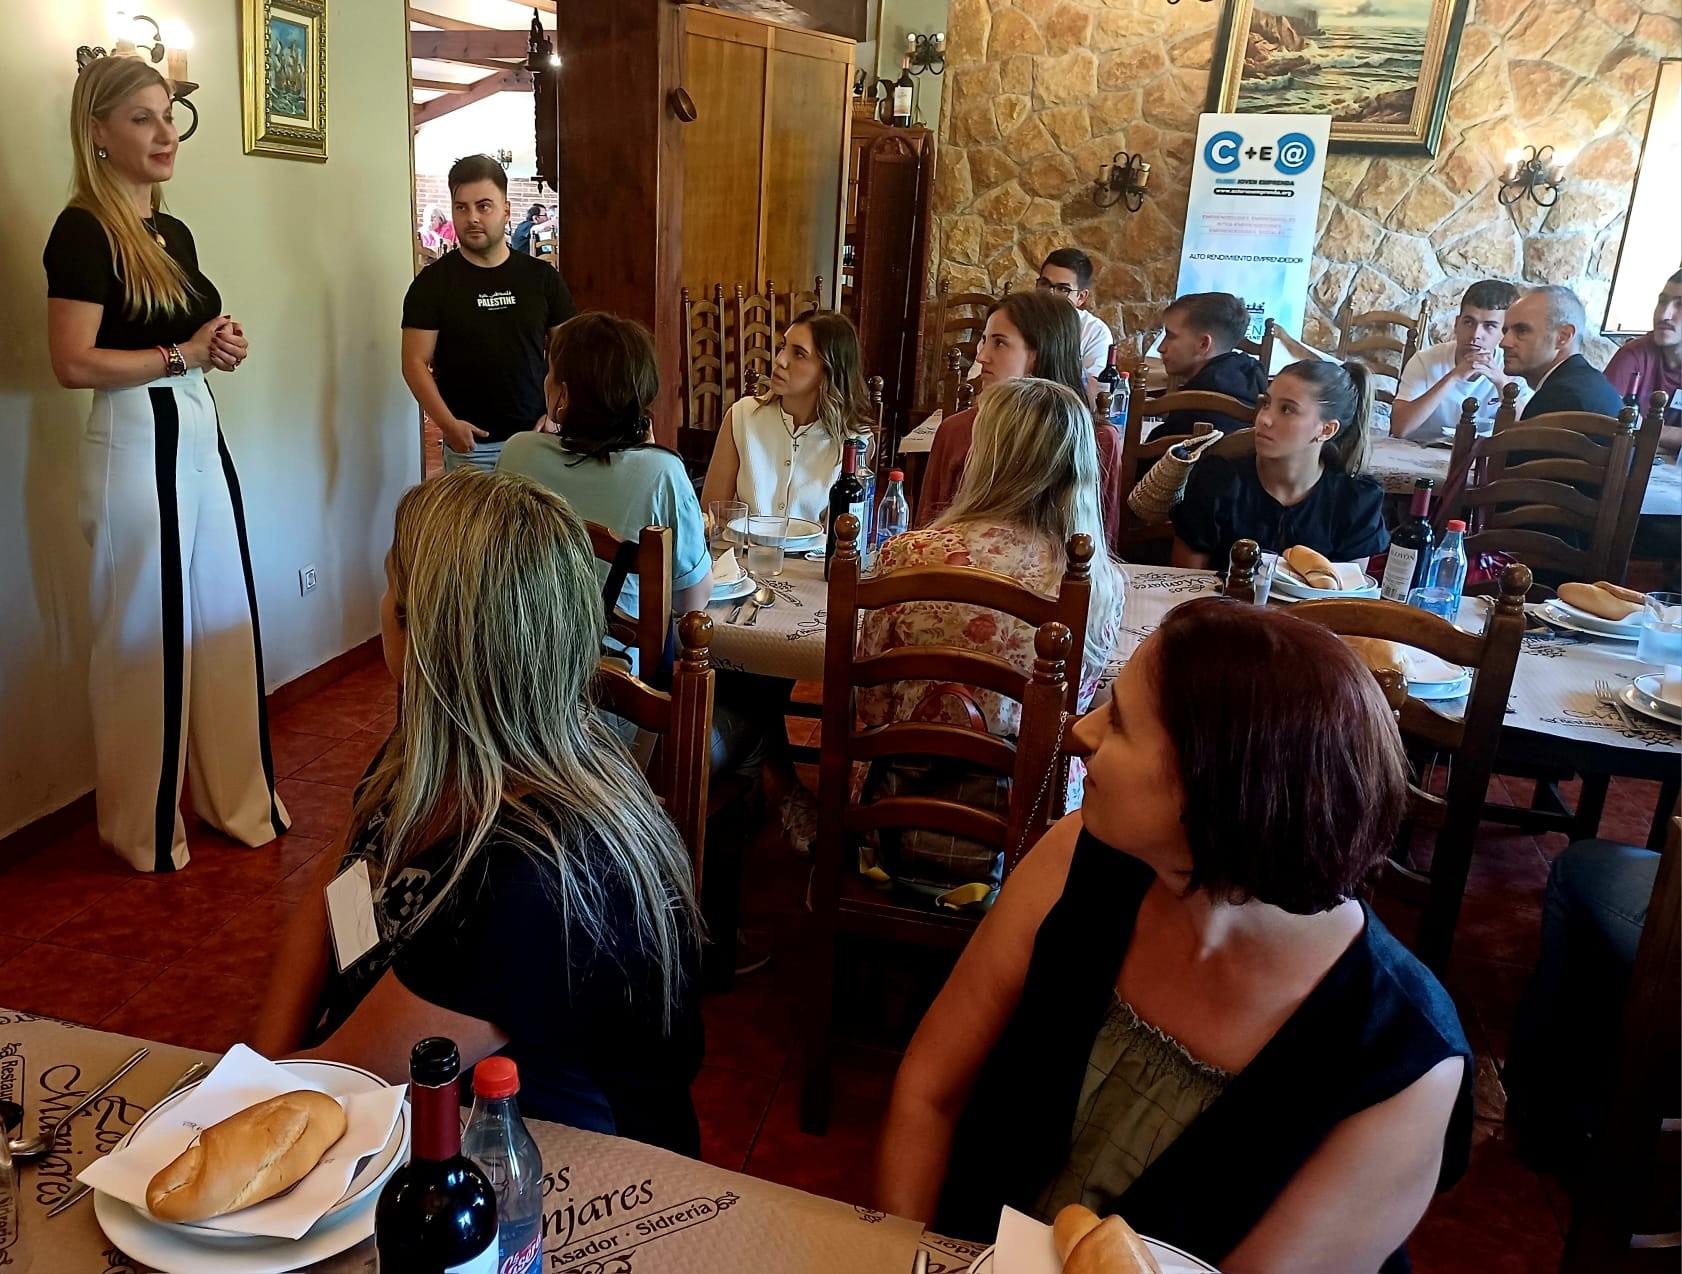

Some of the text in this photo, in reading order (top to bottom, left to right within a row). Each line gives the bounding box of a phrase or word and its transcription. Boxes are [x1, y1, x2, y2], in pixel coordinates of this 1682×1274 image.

[1253, 255, 1304, 264] EMPRENDEDOR
[477, 295, 516, 307] PALESTINE
[542, 1166, 571, 1198] os
[541, 1178, 654, 1250] njares
[551, 1200, 713, 1269] Asador Sidrería
